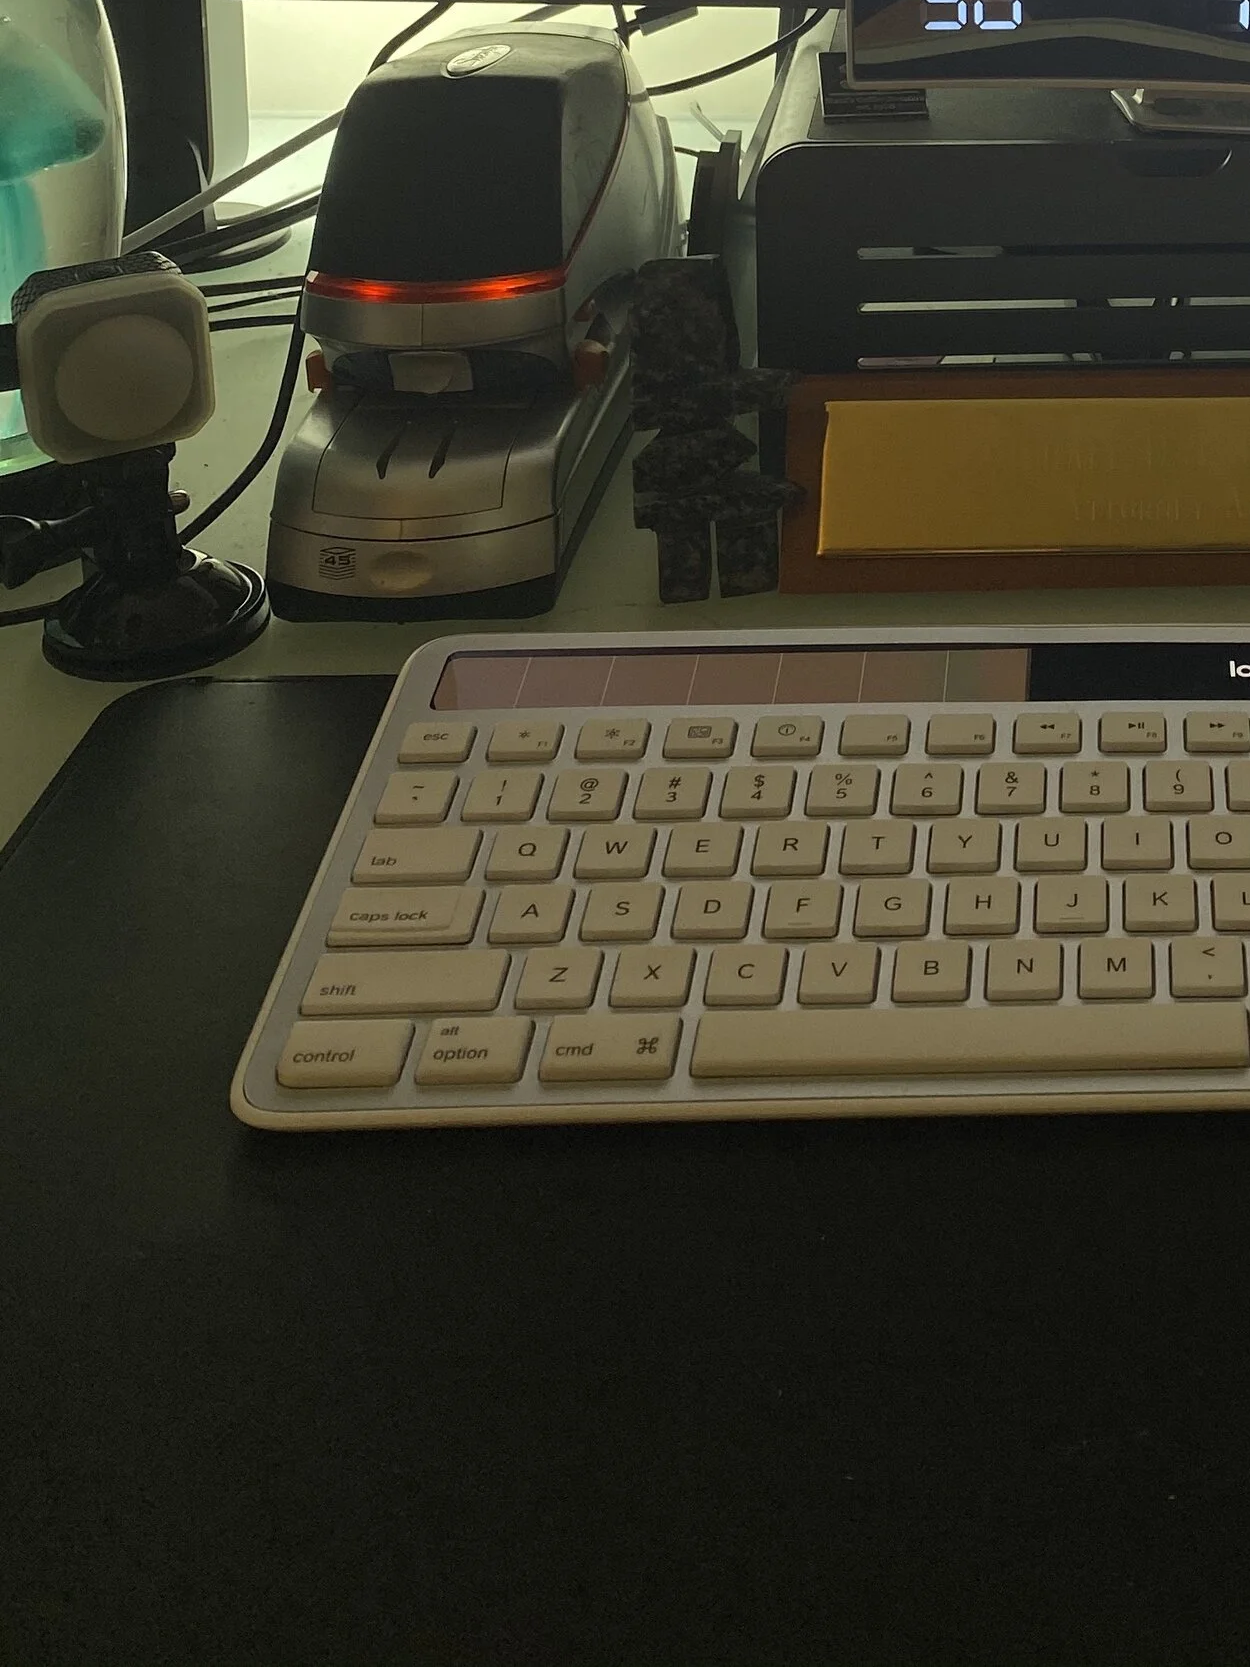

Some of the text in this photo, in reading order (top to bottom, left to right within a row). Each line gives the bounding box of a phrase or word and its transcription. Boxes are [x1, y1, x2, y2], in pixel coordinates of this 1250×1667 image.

[324, 554, 352, 566] 45
[423, 731, 449, 742] esc
[348, 908, 428, 924] caps lock
[319, 983, 357, 997] shift
[292, 1048, 355, 1064] control
[433, 1047, 489, 1065] option
[555, 1042, 593, 1056] cmd
